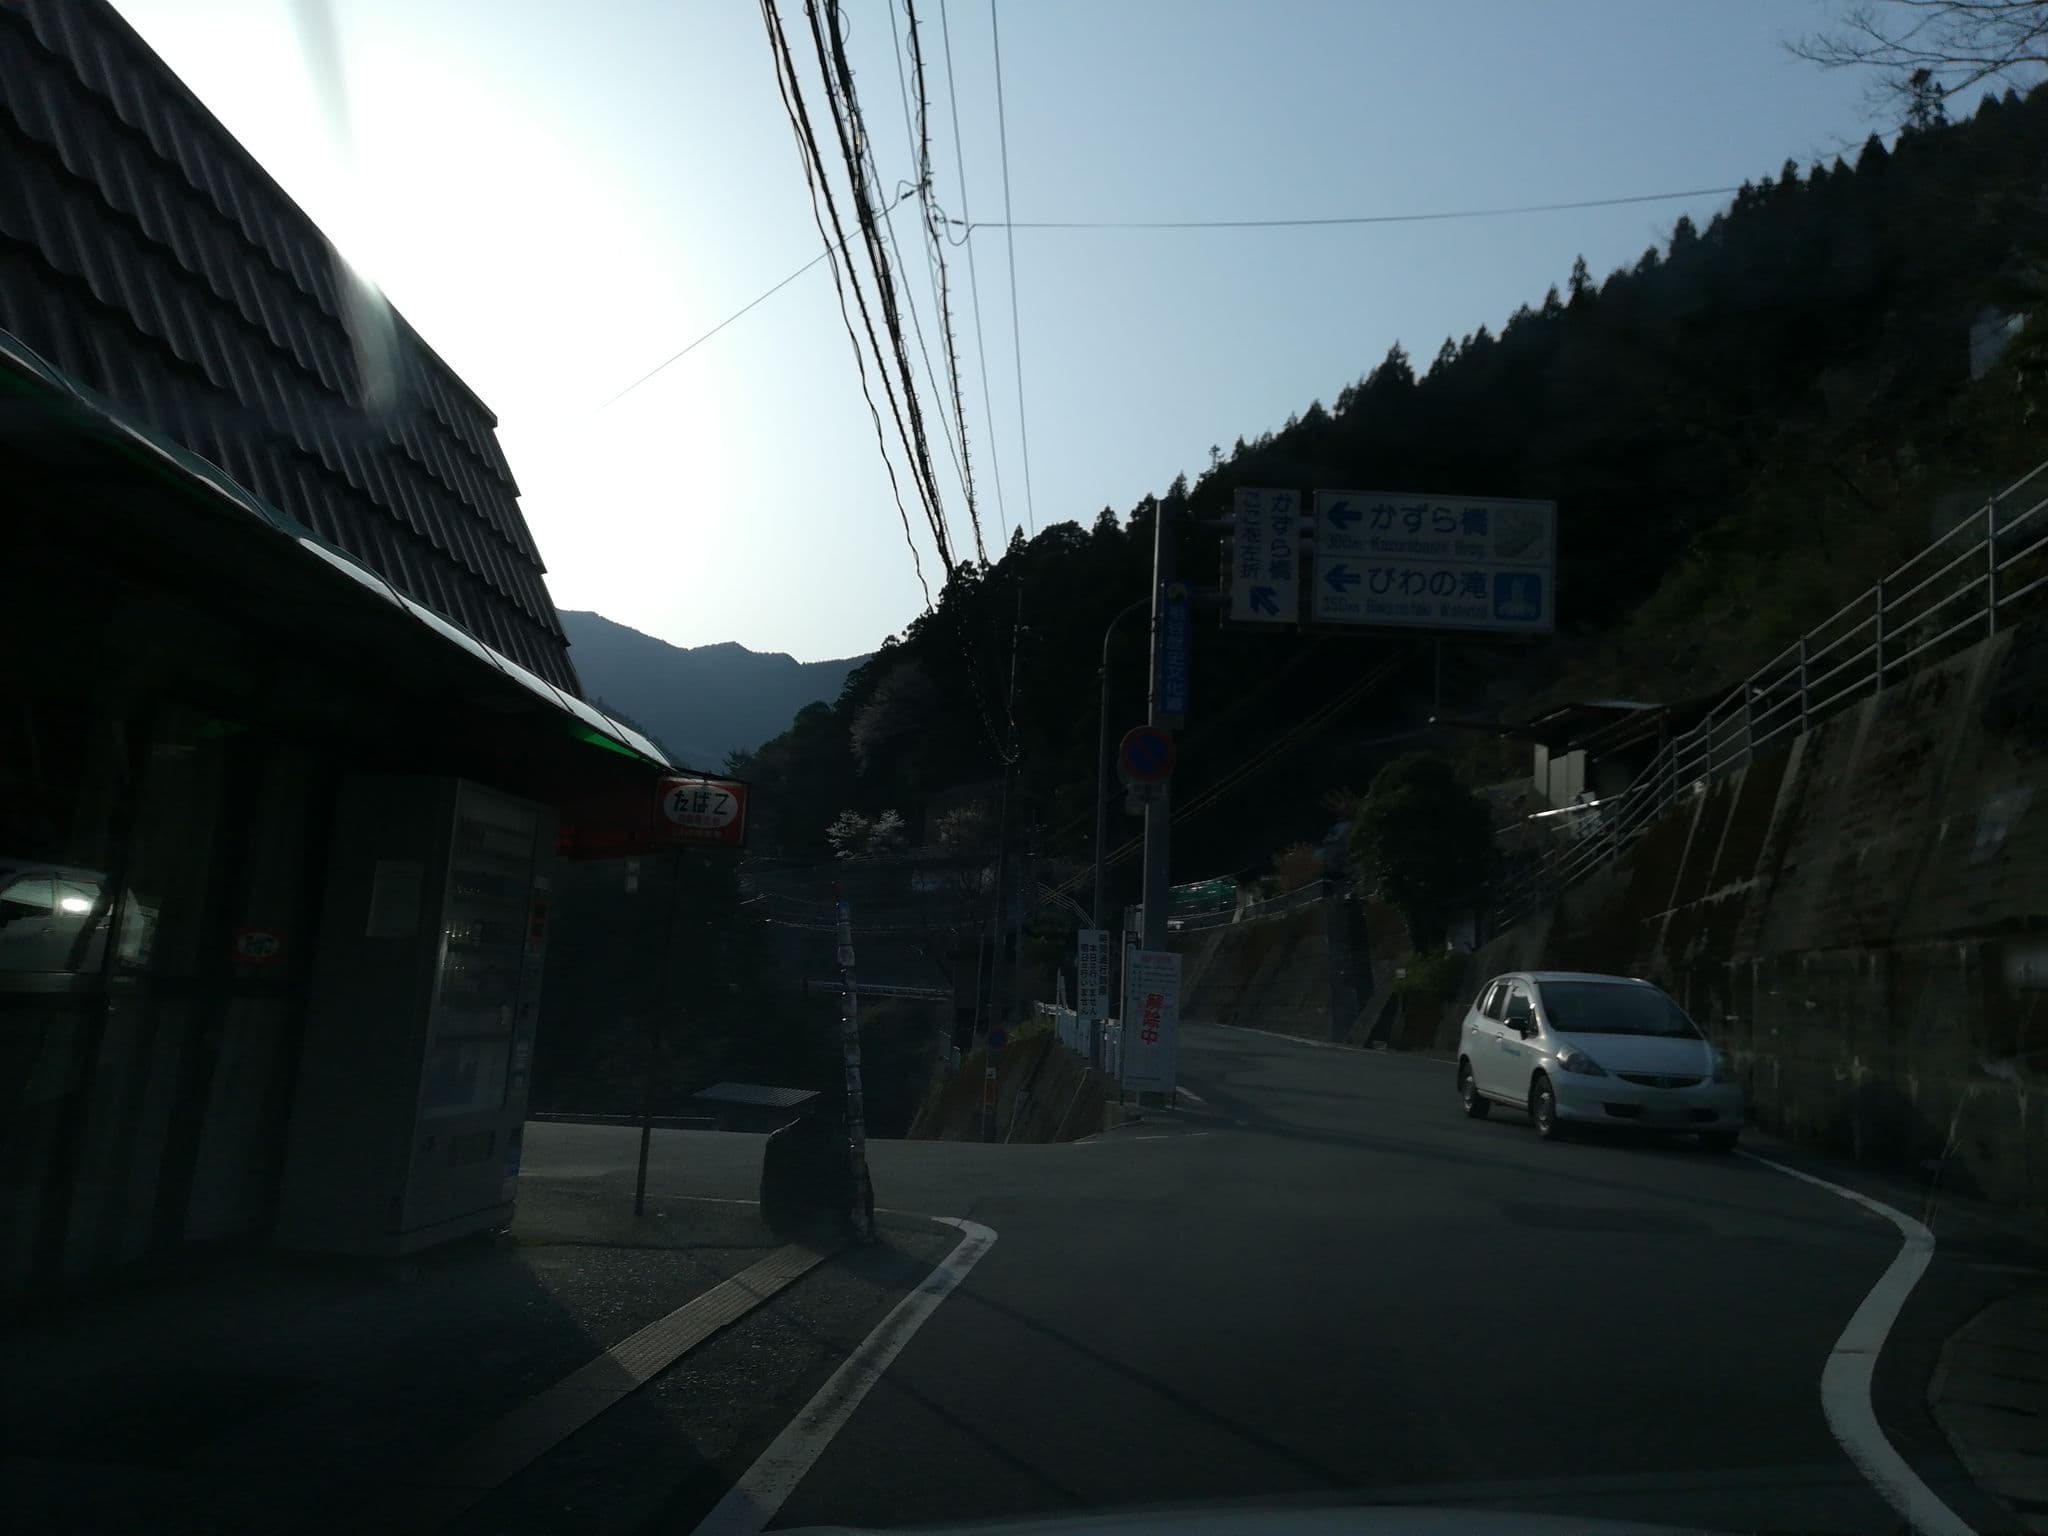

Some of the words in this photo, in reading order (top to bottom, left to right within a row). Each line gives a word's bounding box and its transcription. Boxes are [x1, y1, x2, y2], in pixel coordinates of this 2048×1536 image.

[1239, 490, 1264, 578] ここを左折
[1369, 503, 1488, 536] かずら橋
[1270, 493, 1293, 580] かずら橋
[1367, 567, 1488, 600] びわの滝
[673, 789, 730, 816] たばこ
